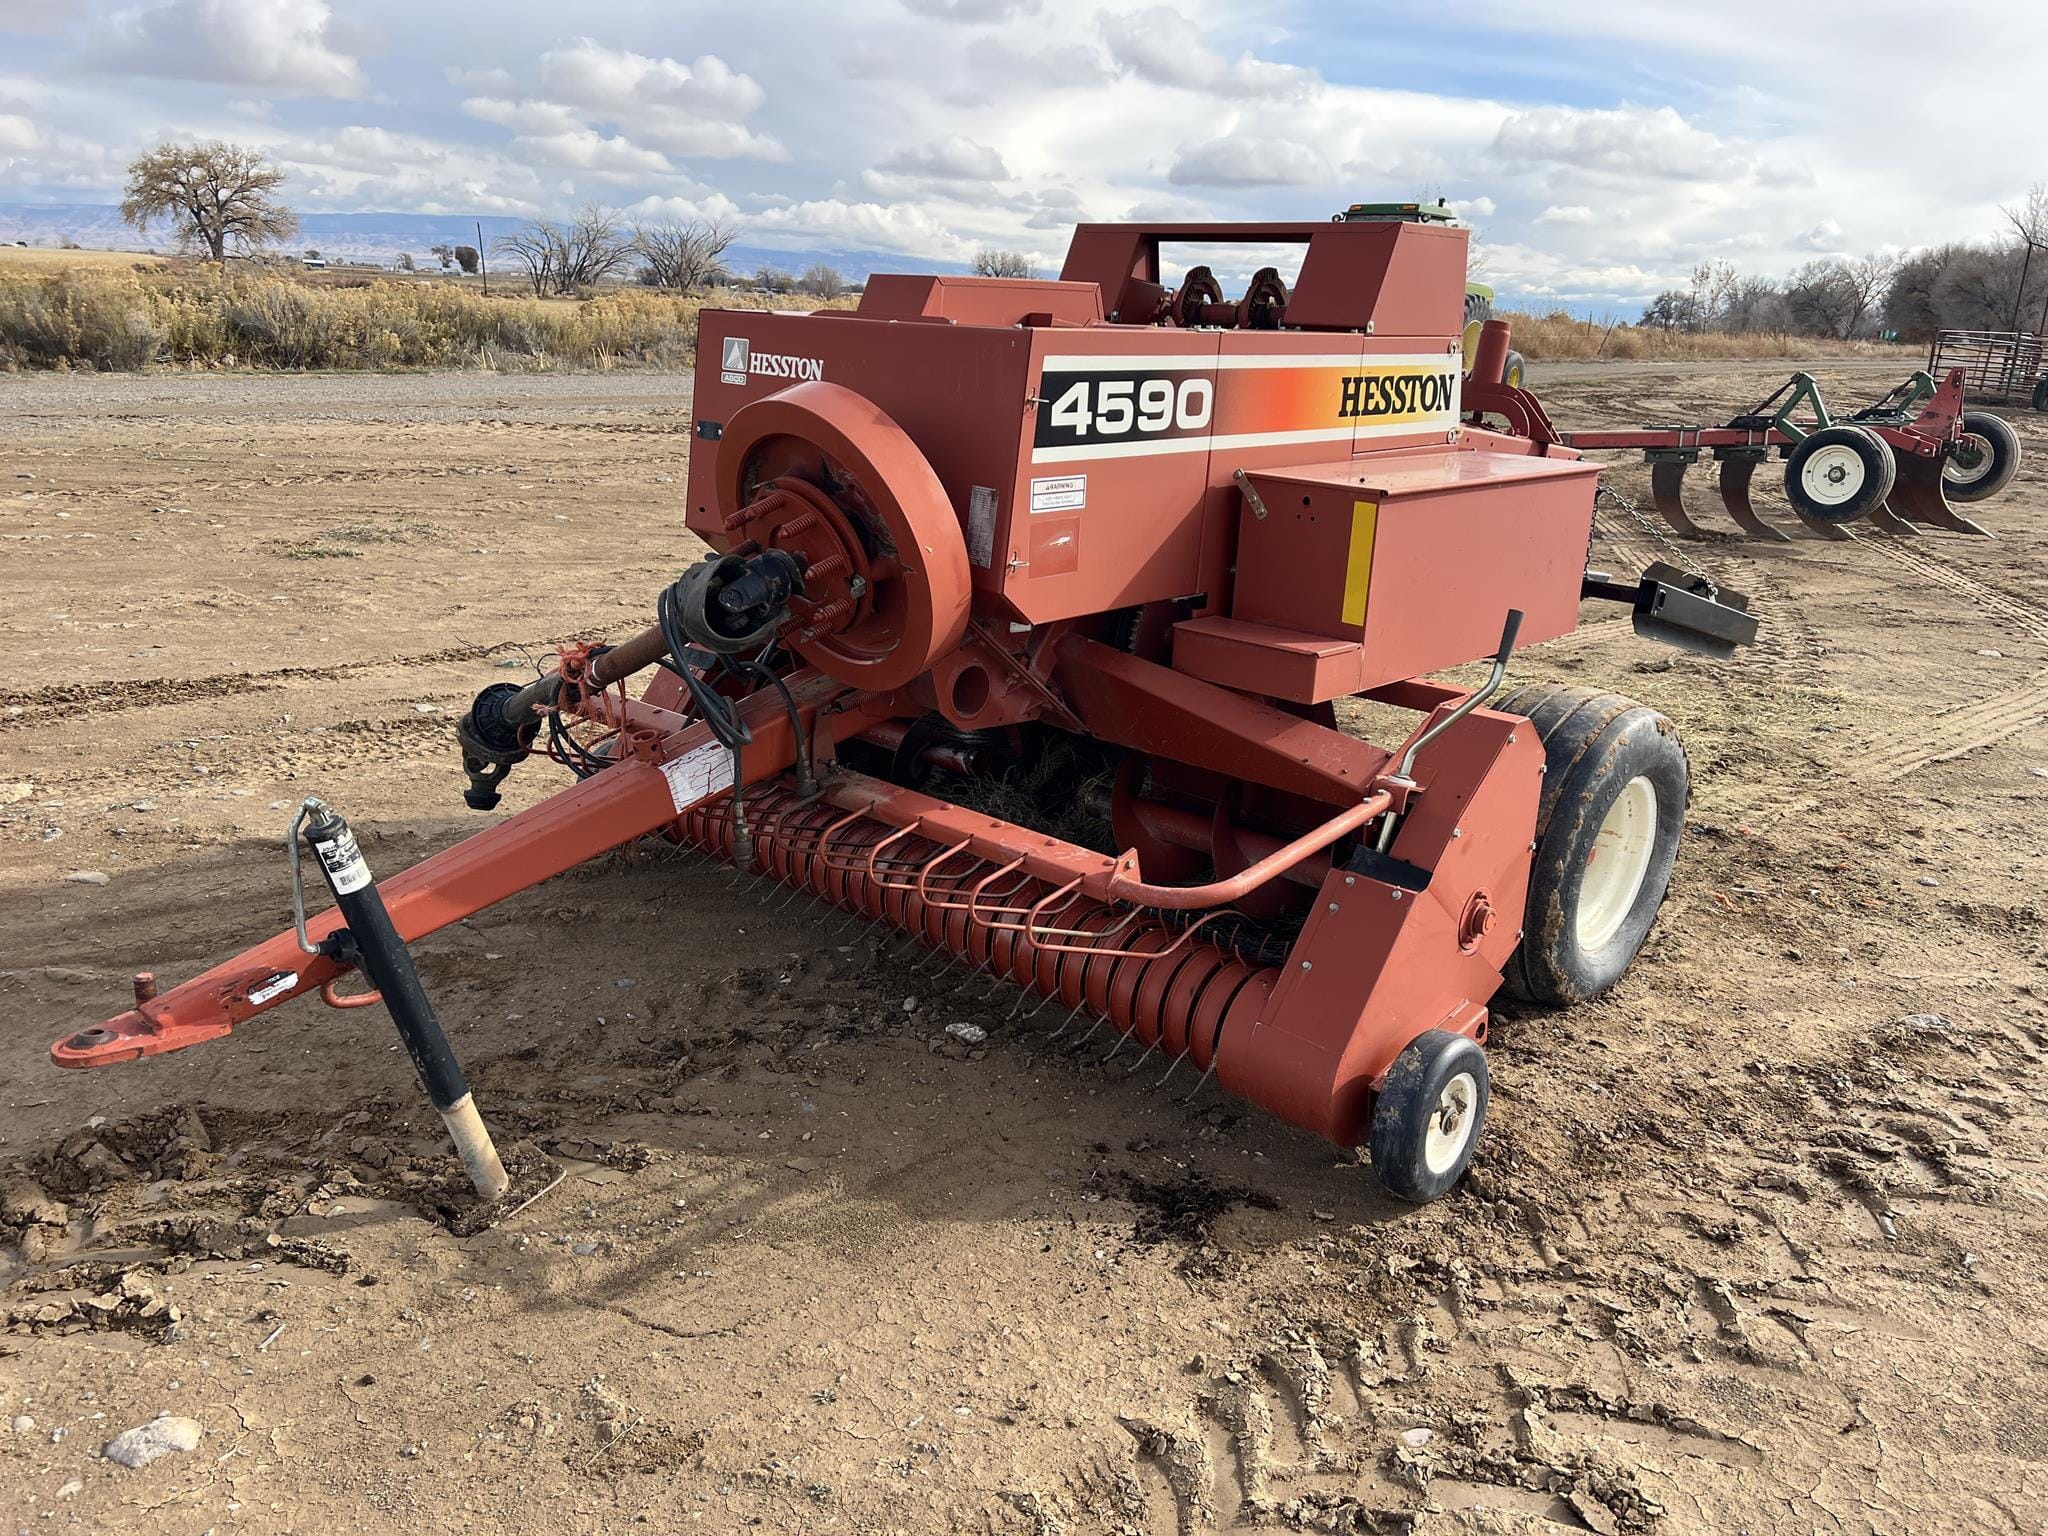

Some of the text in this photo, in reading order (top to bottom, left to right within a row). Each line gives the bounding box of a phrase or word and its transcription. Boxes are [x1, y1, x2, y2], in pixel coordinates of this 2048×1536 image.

[724, 374, 744, 383] AGCO
[749, 352, 824, 381] HESSTON
[1051, 379, 1213, 436] 4590
[1338, 374, 1455, 417] HESSTON
